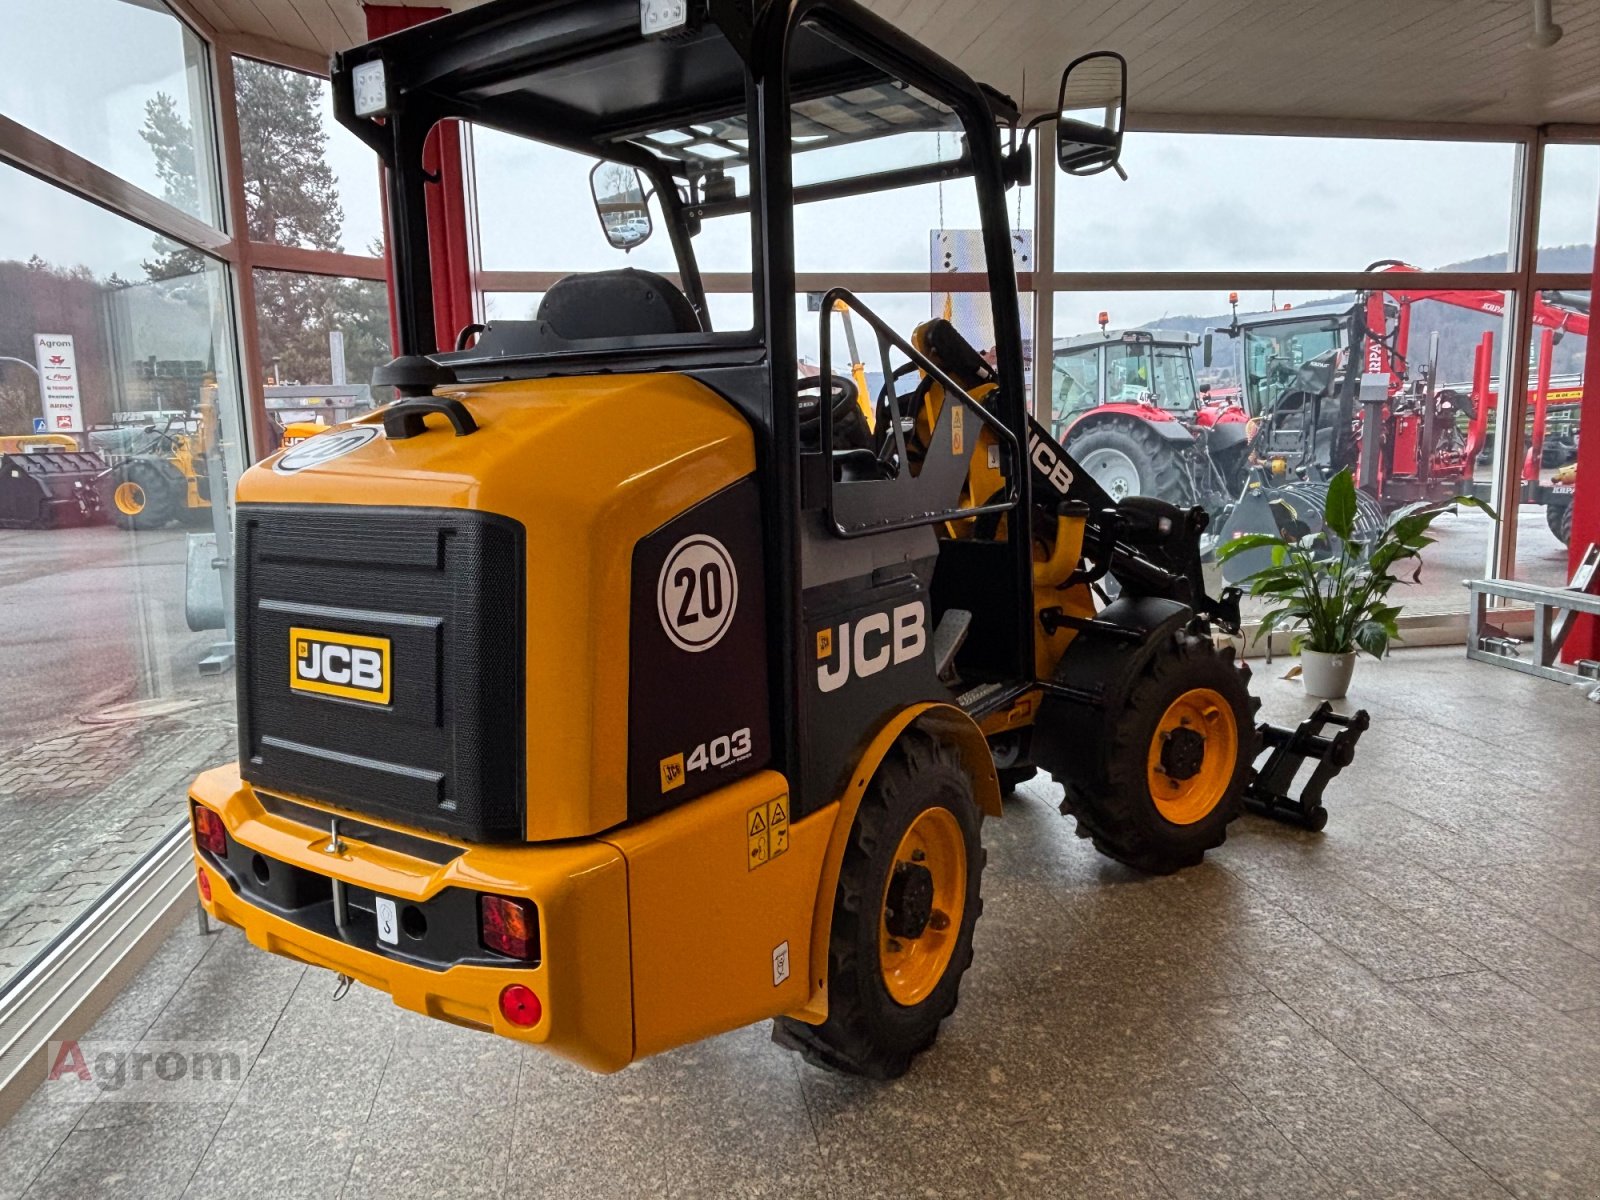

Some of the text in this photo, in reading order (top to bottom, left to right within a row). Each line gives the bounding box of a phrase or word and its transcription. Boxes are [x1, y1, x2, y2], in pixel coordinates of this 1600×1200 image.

[39, 339, 71, 348] Agrom
[674, 562, 722, 627] 20
[298, 643, 382, 689] JCB
[817, 600, 926, 693] JCB
[686, 727, 751, 772] 403
